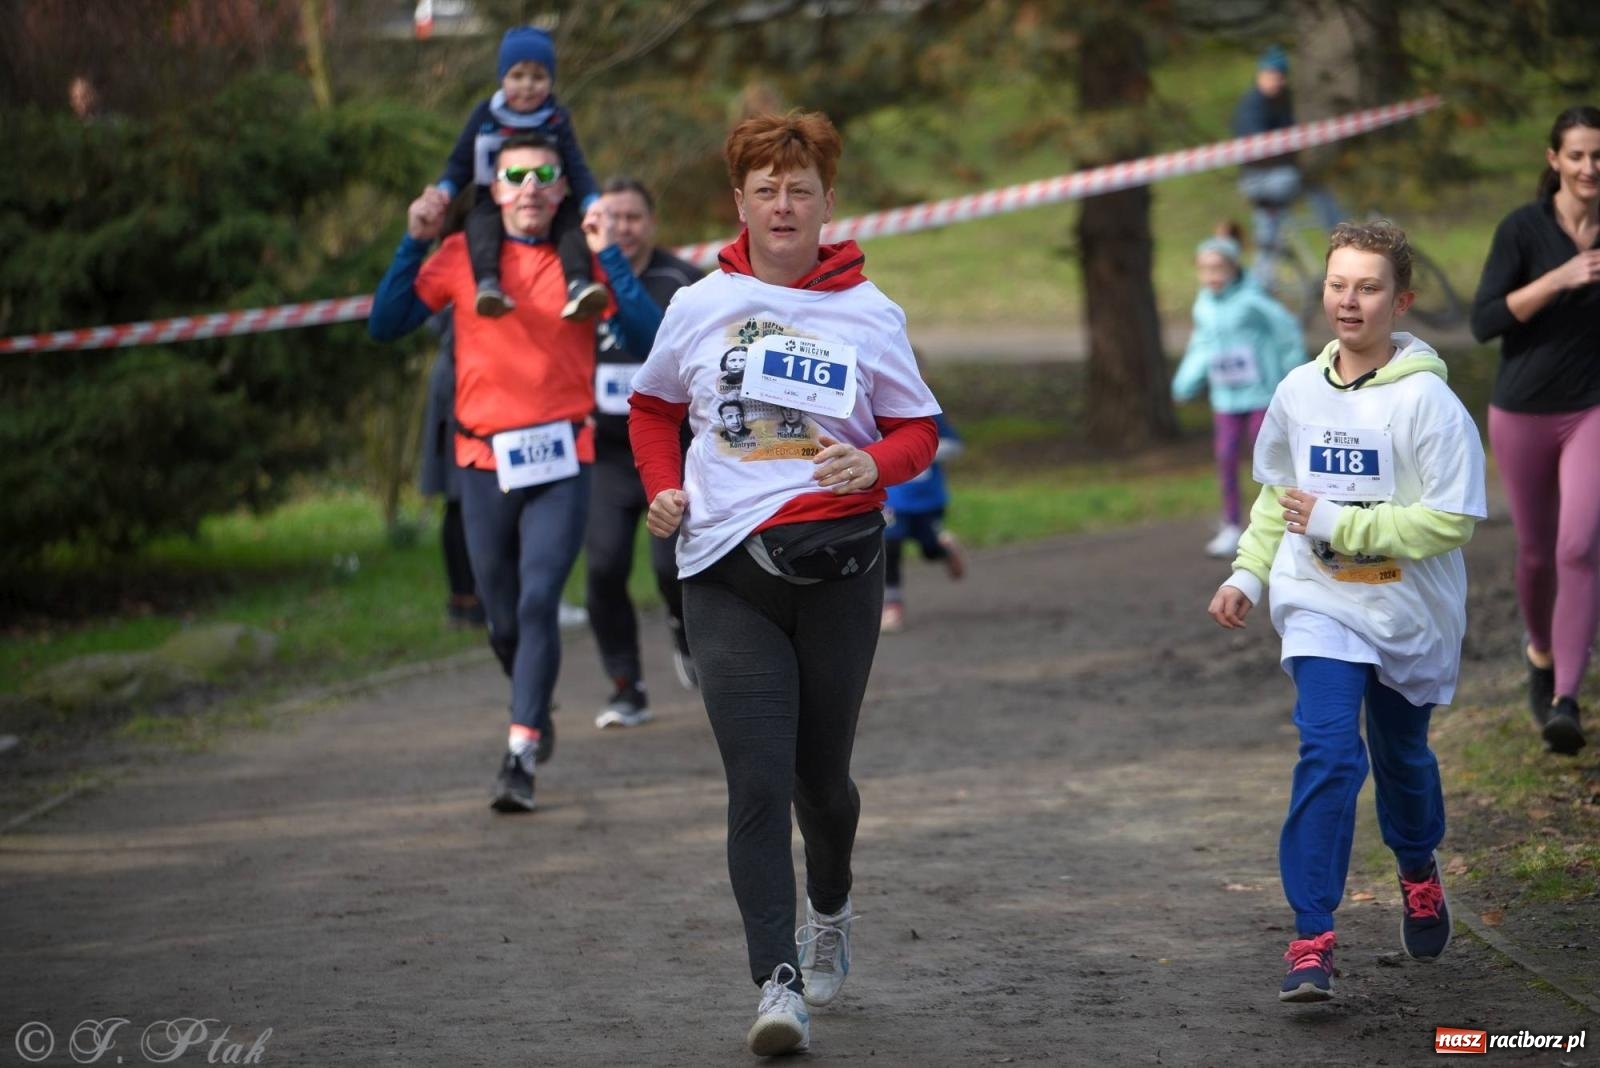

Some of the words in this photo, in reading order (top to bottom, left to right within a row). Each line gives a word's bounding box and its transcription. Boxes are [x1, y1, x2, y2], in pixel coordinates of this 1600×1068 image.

[799, 345, 830, 357] WILCZYM
[782, 355, 831, 385] 116
[1333, 436, 1360, 445] WILCZYM
[1321, 448, 1364, 474] 118
